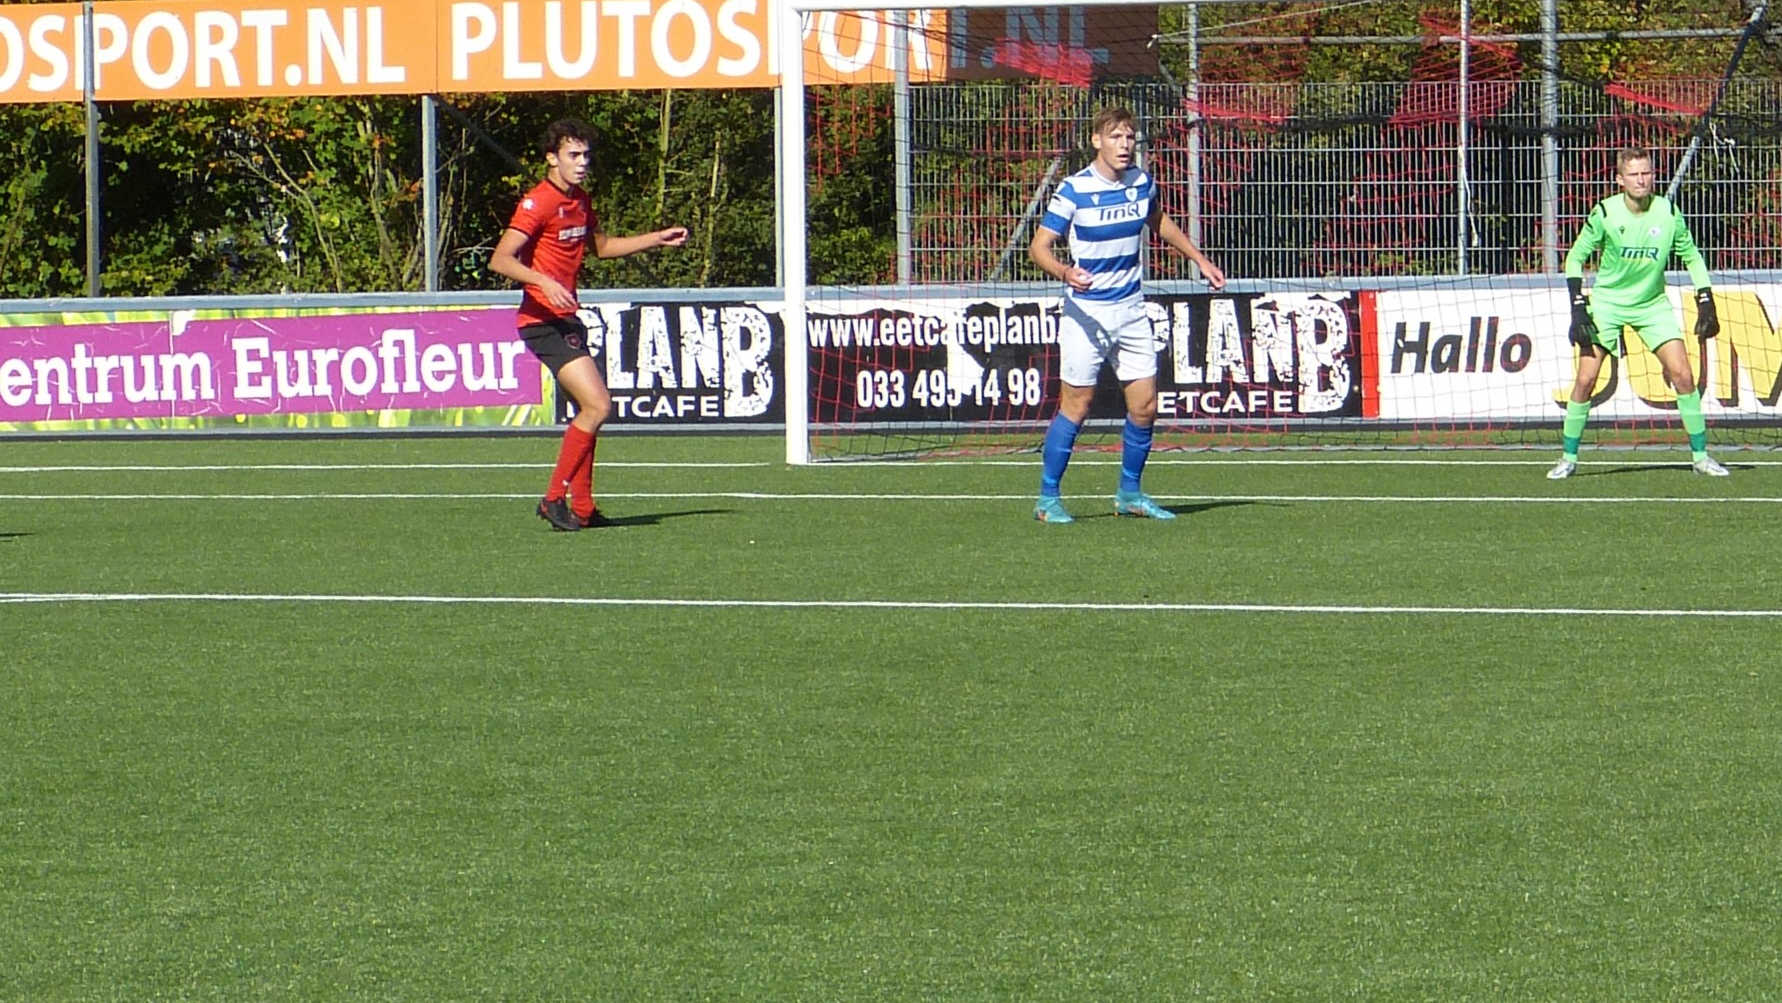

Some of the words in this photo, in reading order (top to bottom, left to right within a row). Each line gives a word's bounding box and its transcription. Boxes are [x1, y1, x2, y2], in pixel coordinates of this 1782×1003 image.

[0, 344, 215, 406] entrum
[232, 330, 525, 399] Eurofleur
[1391, 317, 1533, 373] Hallo
[857, 369, 905, 407] 033
[1007, 368, 1041, 406] 98
